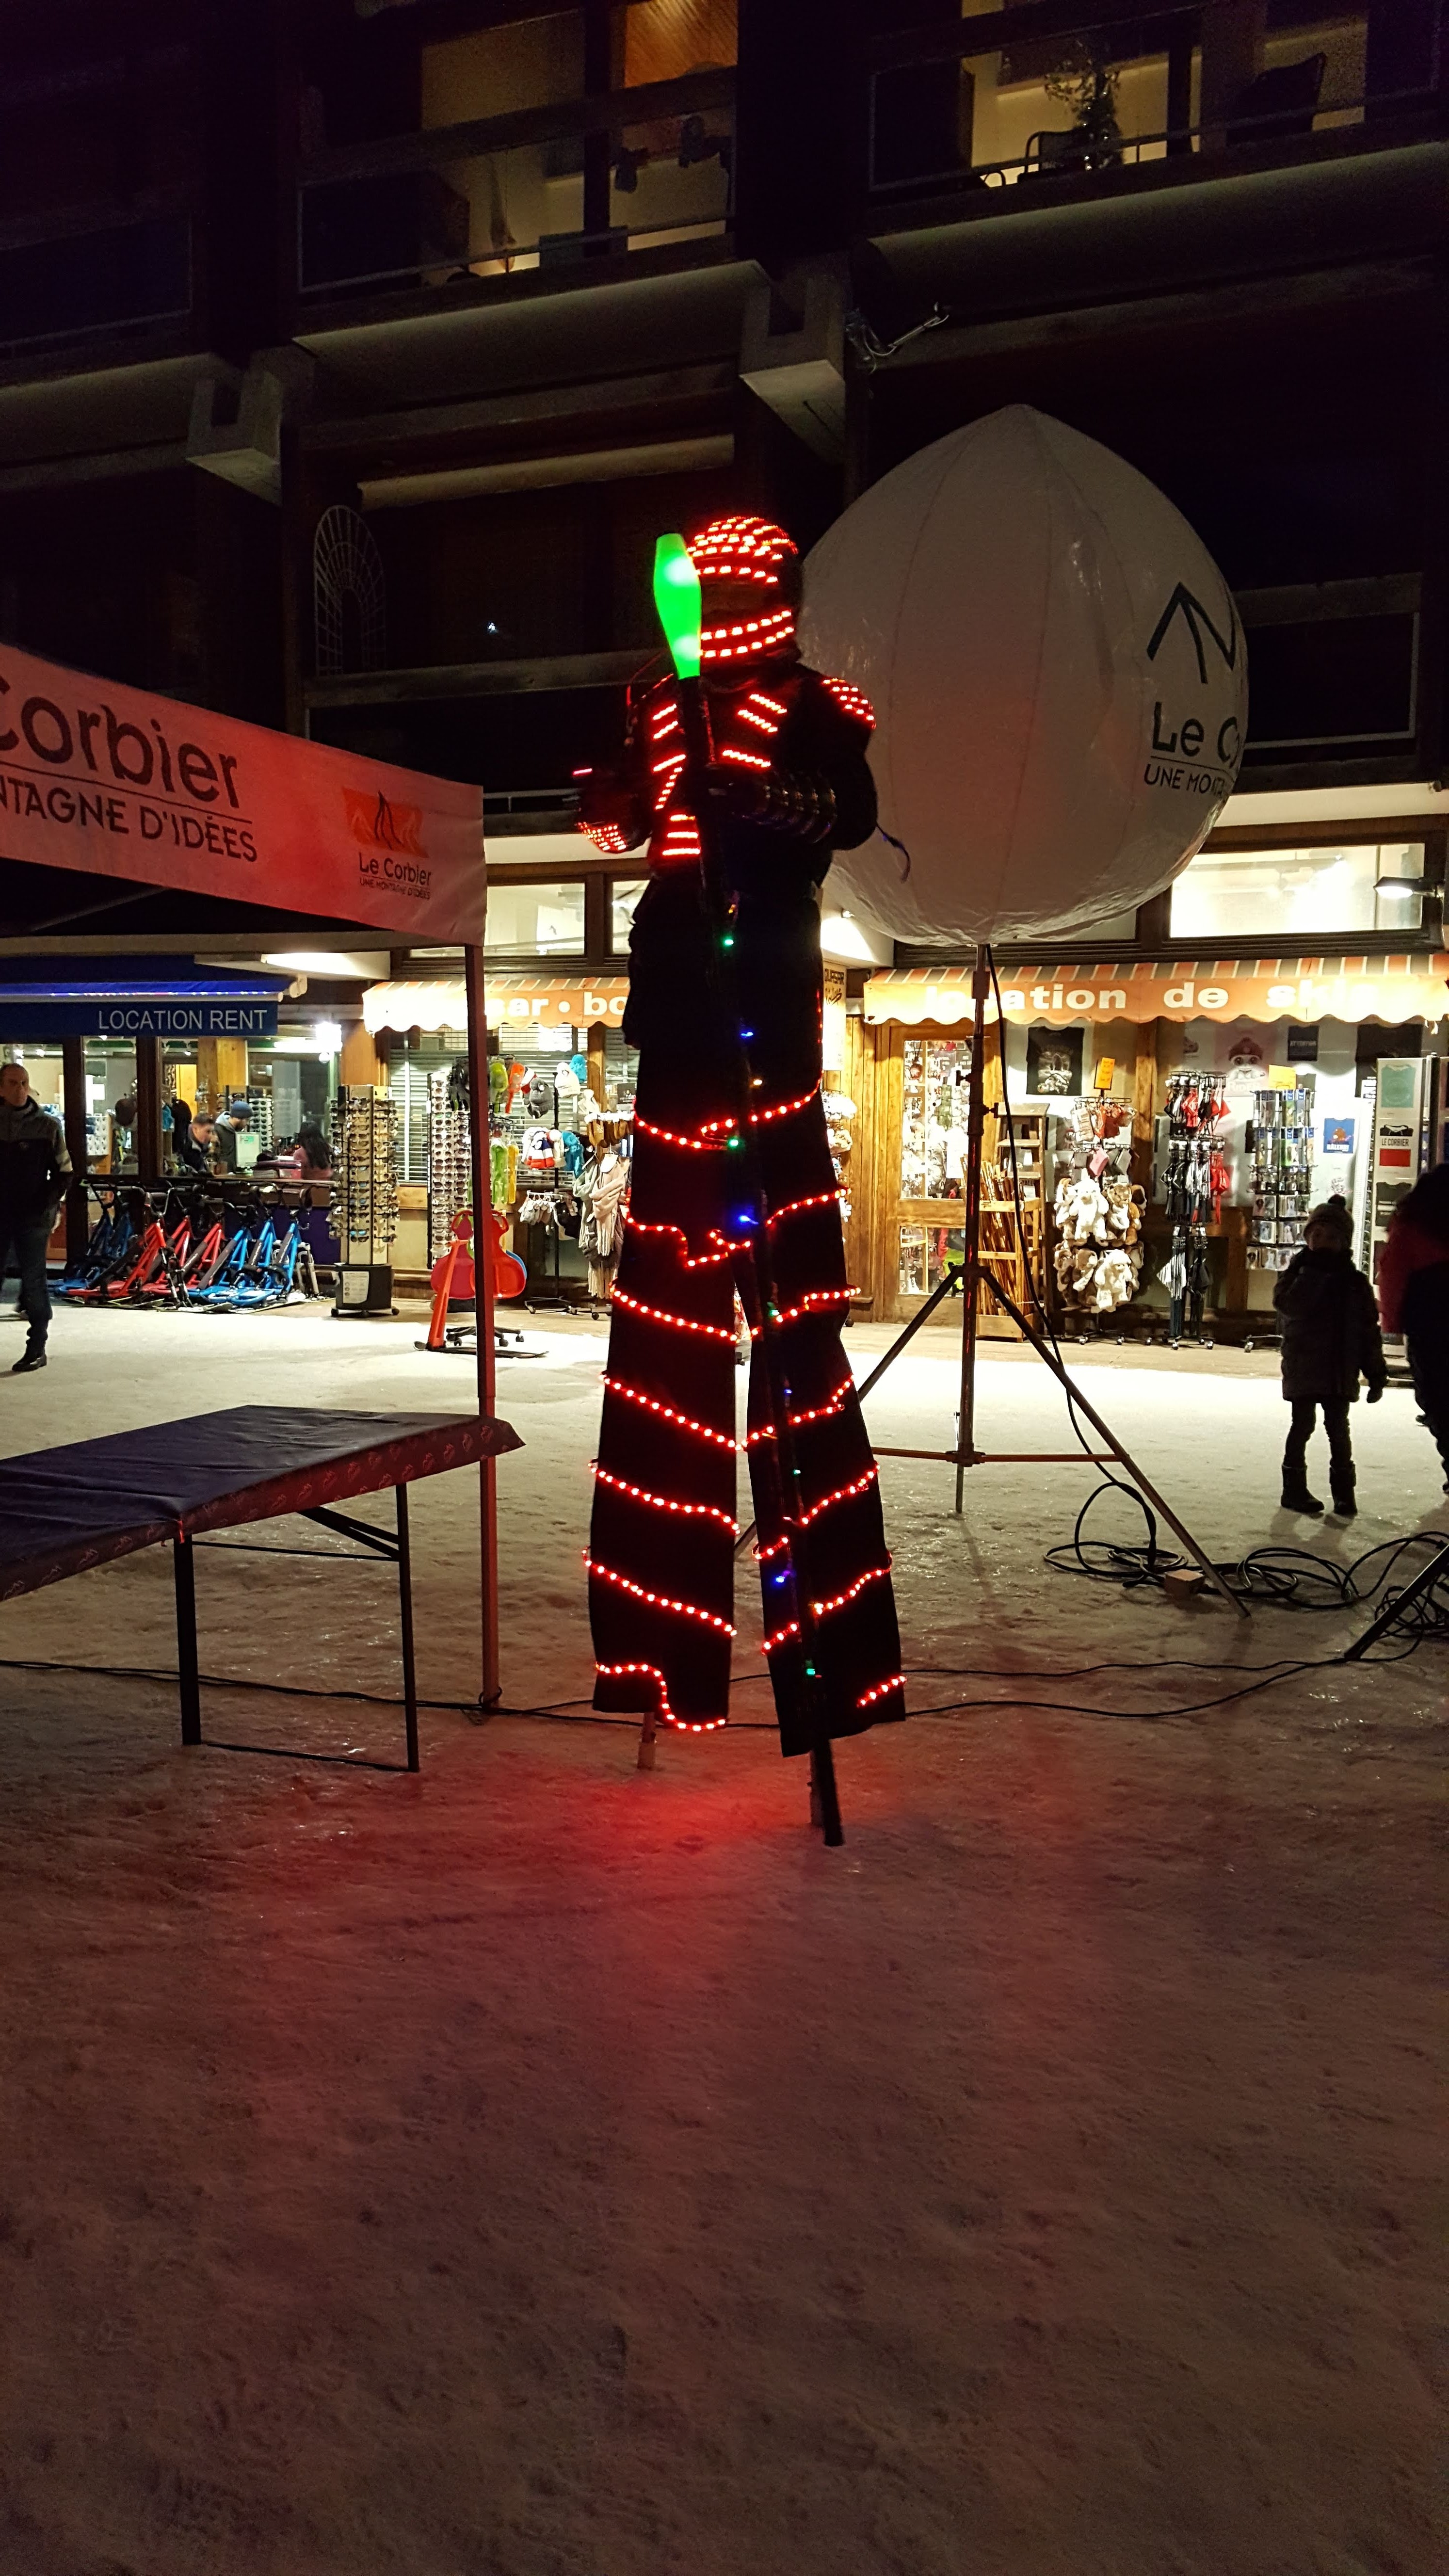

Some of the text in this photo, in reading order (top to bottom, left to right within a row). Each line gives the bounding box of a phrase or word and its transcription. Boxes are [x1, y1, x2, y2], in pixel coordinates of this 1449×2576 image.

[1152, 701, 1205, 757] Le
[1143, 764, 1185, 789] UNE
[140, 805, 258, 862] D'IDÉES
[359, 852, 432, 886] Le Corbier
[360, 878, 374, 888] UNE
[1164, 982, 1229, 1008] de
[99, 1010, 267, 1030] LOCATION RENT
